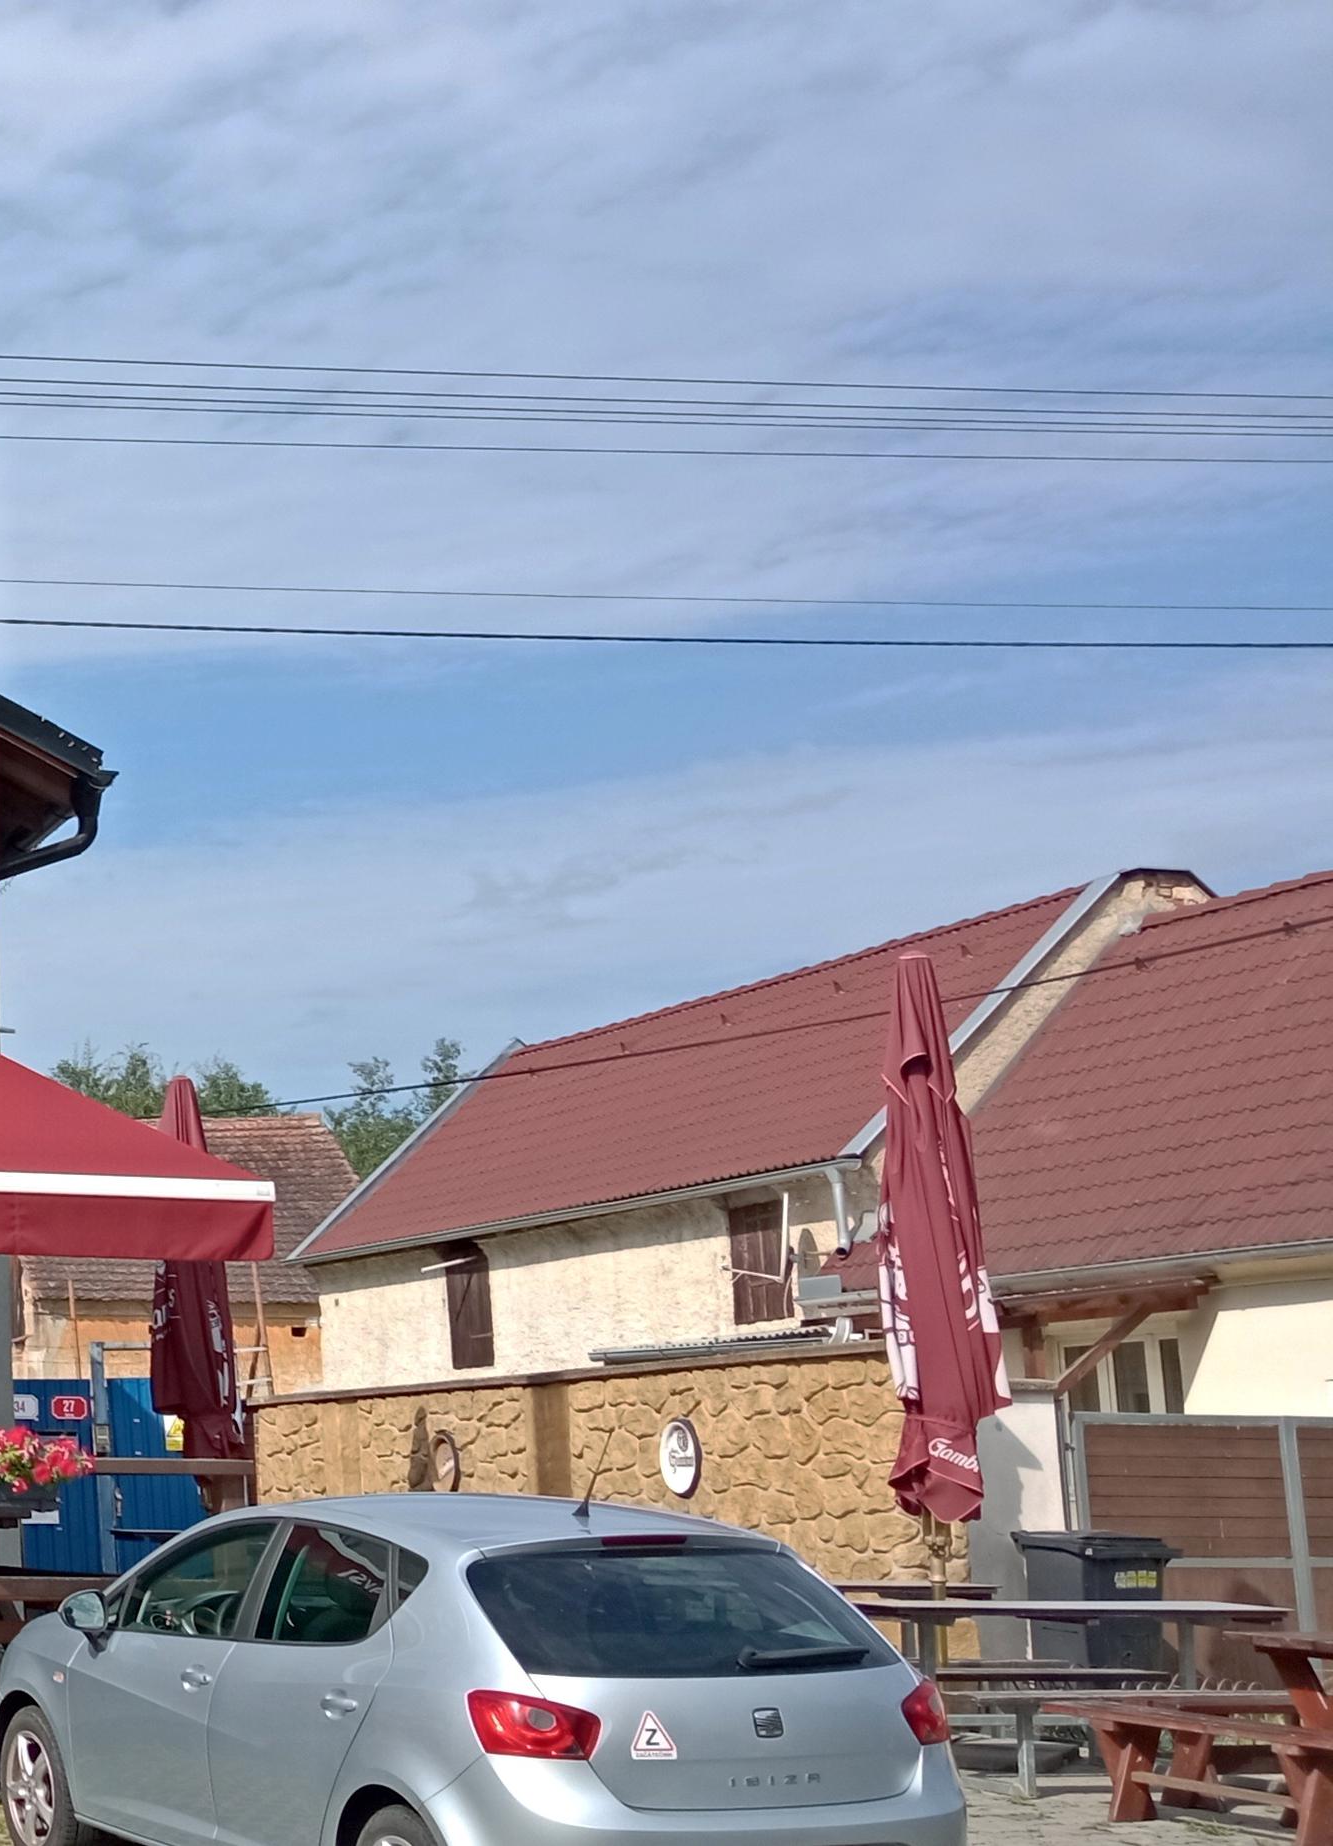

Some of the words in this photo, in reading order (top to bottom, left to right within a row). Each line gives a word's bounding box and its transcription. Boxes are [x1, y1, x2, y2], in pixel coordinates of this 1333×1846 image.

[62, 1400, 76, 1413] 27
[645, 1728, 660, 1746] Z
[729, 1773, 821, 1788] IBIZA
